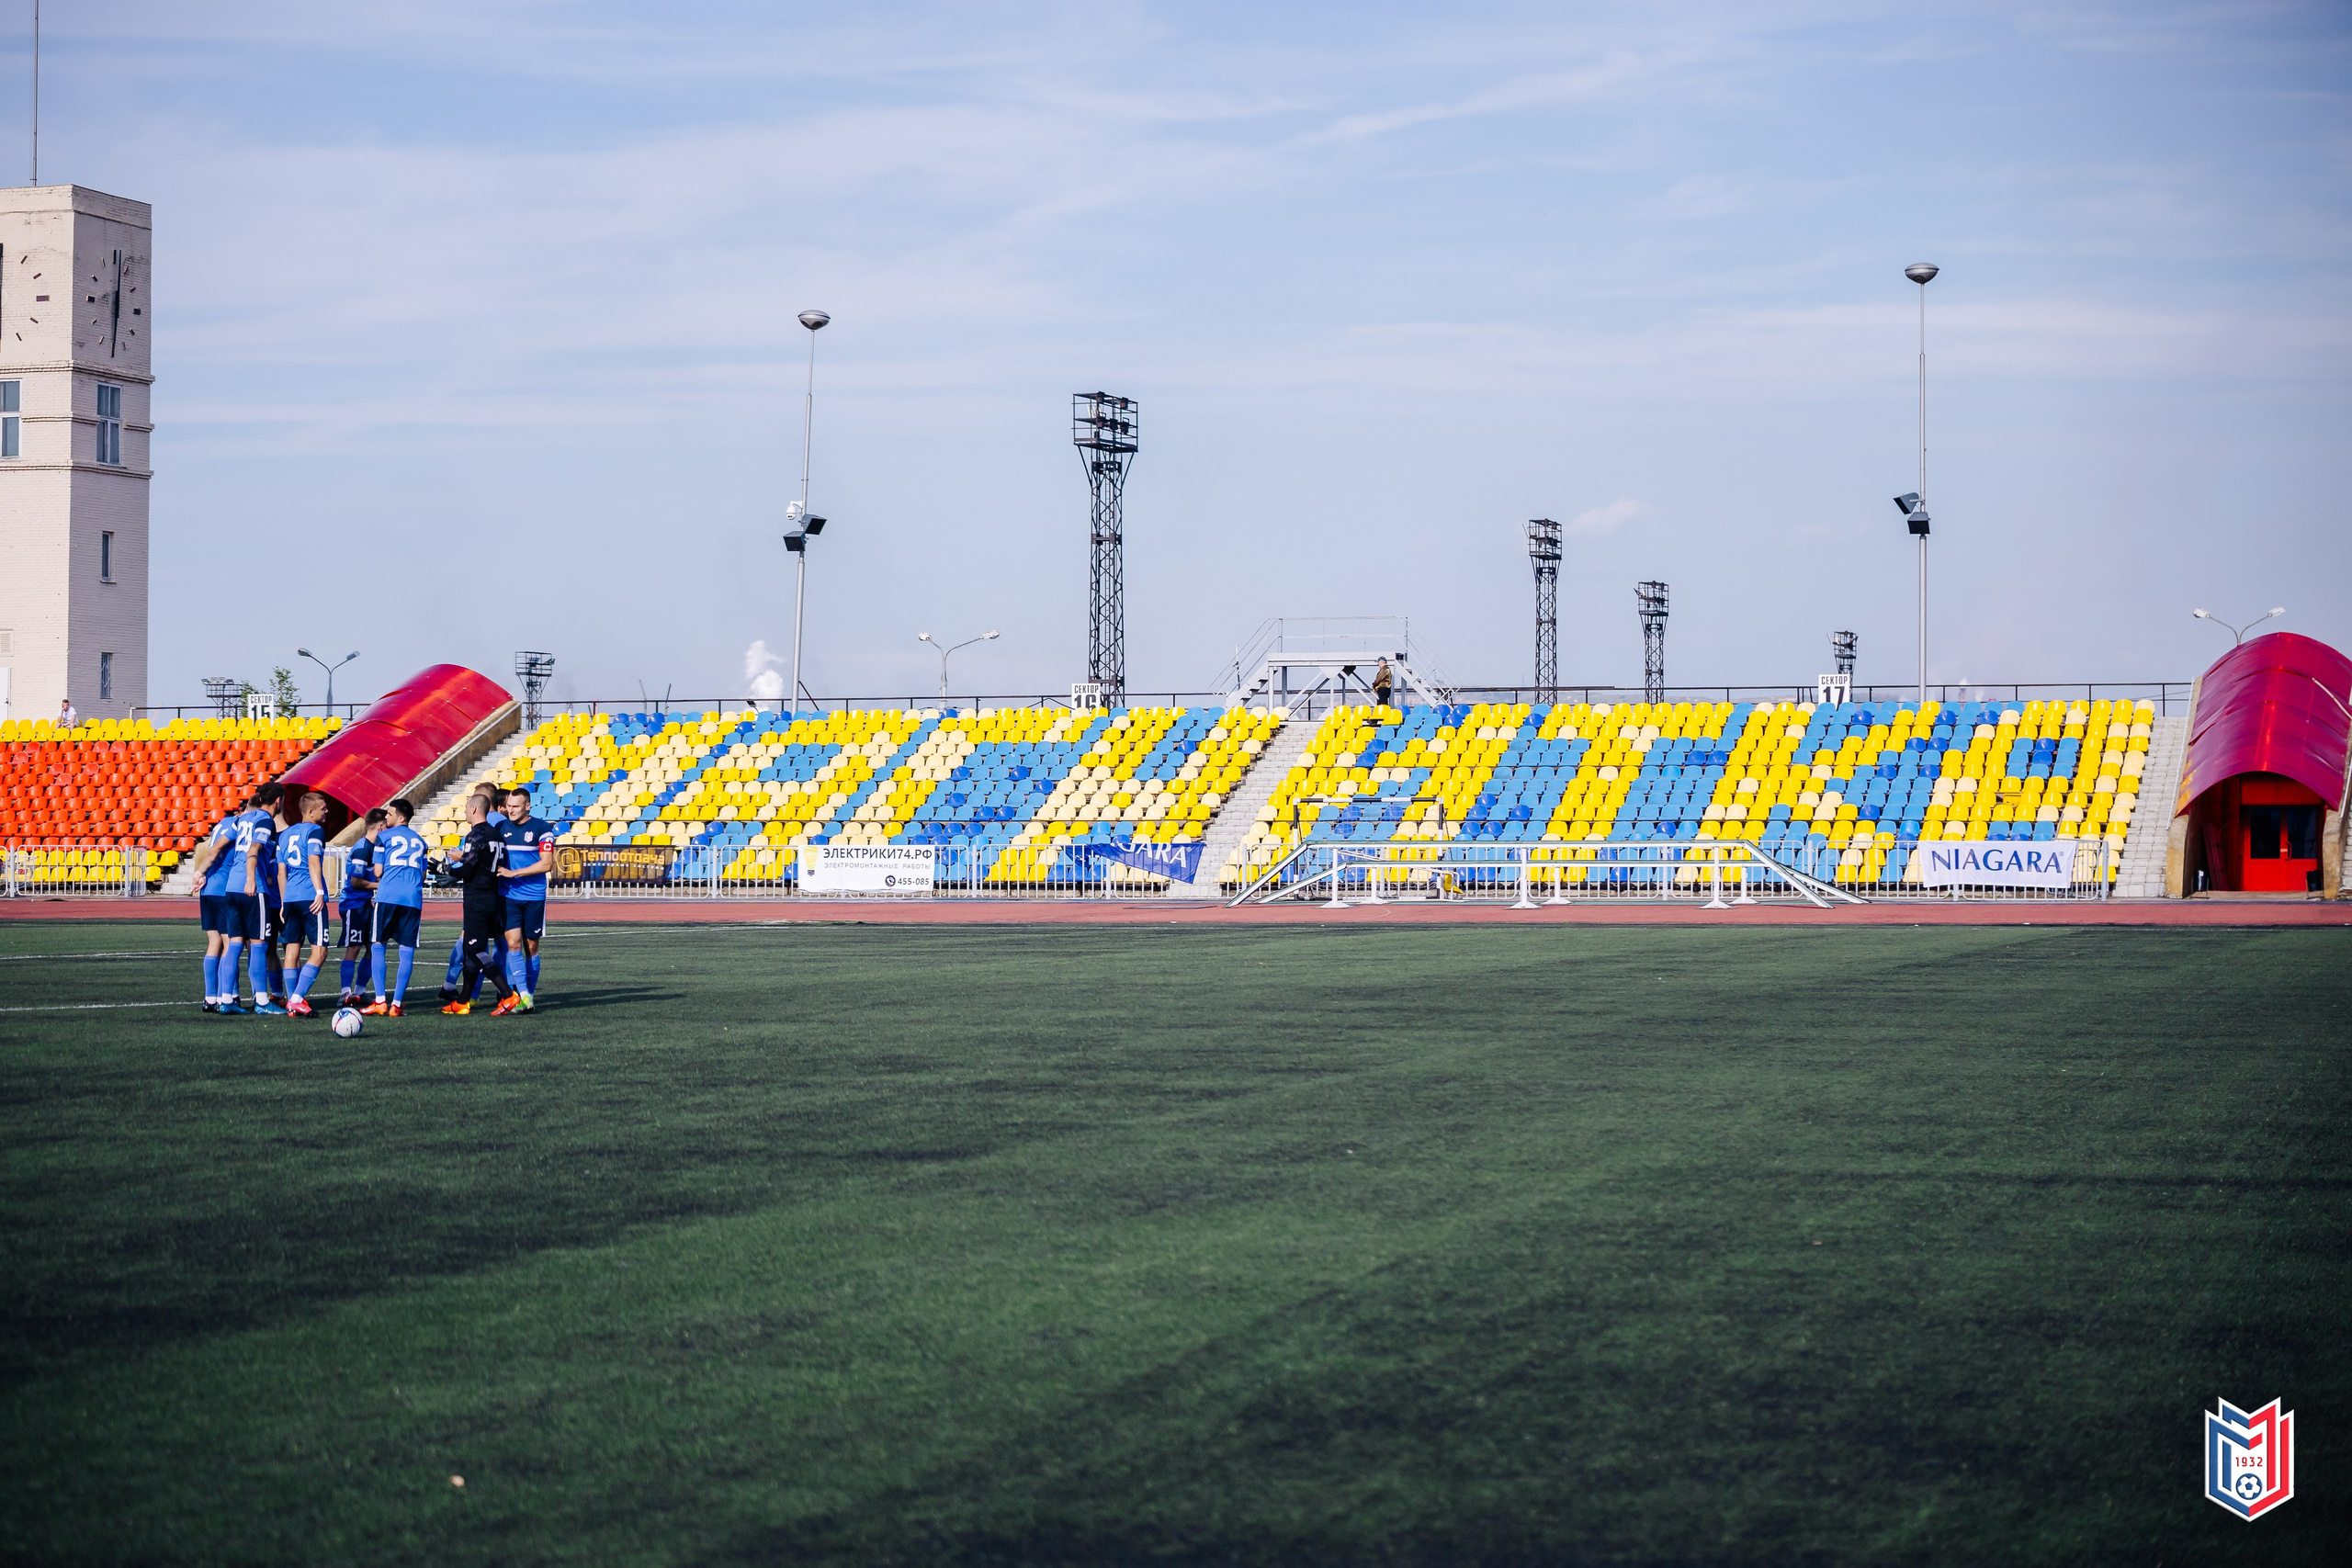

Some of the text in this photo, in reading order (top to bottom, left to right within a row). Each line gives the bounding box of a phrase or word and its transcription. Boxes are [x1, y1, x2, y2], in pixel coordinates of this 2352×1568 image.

[1821, 675, 1848, 685] СЕКТОР
[1074, 684, 1099, 694] СЕКТОР
[250, 695, 273, 704] СЕКТОР
[1074, 694, 1097, 714] 16
[1823, 686, 1845, 711] 17
[287, 834, 301, 866] 5
[389, 835, 424, 869] 22
[823, 848, 933, 860] ЭЛЕКТРИКИ74.РФ
[1931, 848, 2063, 874] NIAGARA
[897, 877, 930, 886] 455-085
[323, 929, 330, 942] 5
[350, 929, 363, 943] 21
